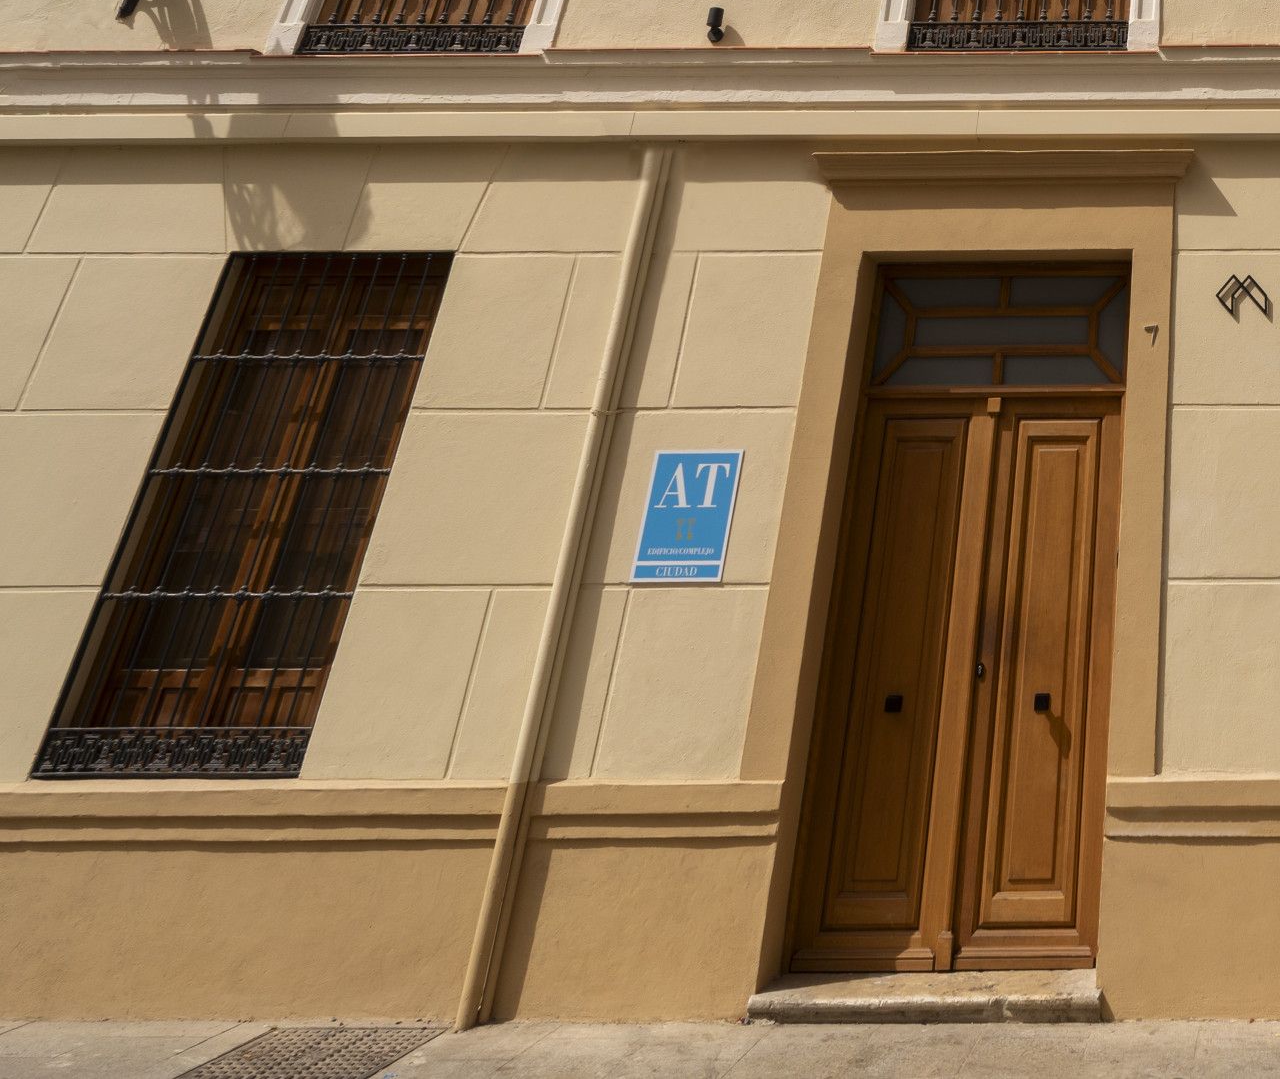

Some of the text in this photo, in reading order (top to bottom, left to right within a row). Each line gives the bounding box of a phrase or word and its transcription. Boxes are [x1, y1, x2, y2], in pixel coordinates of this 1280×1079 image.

[1144, 324, 1160, 347] 7
[654, 462, 731, 508] AT
[655, 566, 698, 577] CIUDAD
